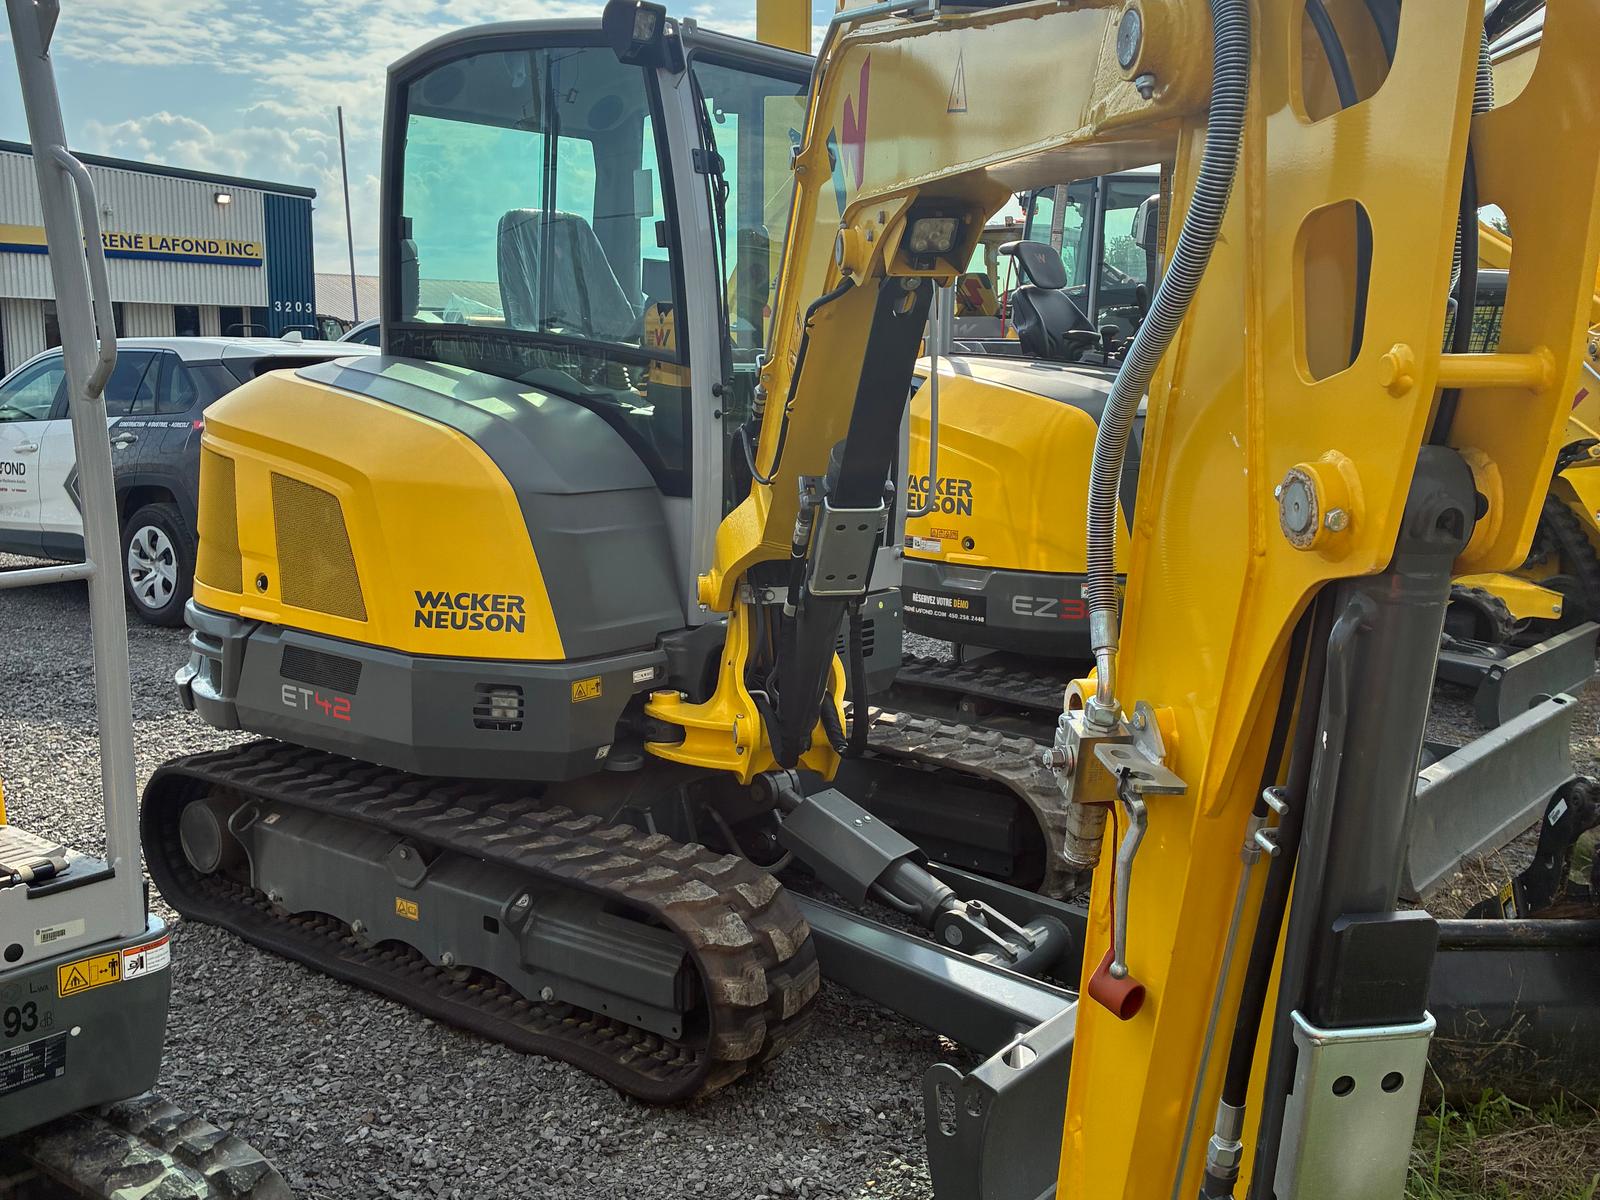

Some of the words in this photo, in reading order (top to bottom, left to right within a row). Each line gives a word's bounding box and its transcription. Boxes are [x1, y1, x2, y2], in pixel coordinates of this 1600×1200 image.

[226, 242, 259, 257] INC.
[274, 300, 312, 313] 3203
[907, 475, 974, 498] ACKER
[907, 492, 973, 516] EUSON
[414, 590, 526, 613] WACKER
[936, 596, 953, 607] VOTRE
[953, 598, 969, 609] DÉMO
[1012, 595, 1088, 620] EZ3
[414, 610, 526, 633] NEUSON
[281, 684, 352, 721] ET42
[3, 1001, 39, 1038] 93
